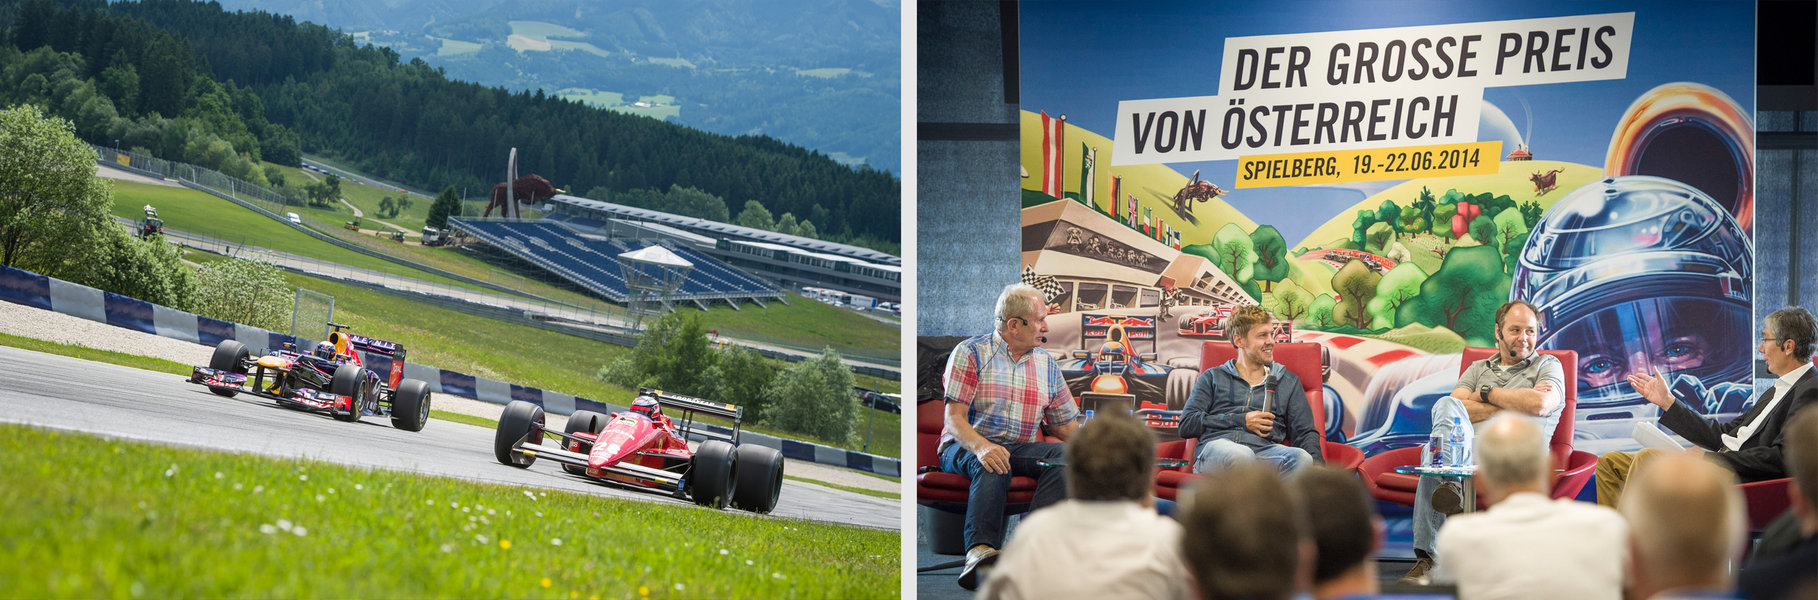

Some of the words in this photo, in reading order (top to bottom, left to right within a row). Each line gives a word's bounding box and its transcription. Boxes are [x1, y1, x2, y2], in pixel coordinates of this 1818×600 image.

[1233, 45, 1311, 91] DER
[1326, 34, 1482, 86] GROSSE
[1494, 25, 1616, 76] PREIS
[1132, 109, 1207, 155] VON
[1221, 94, 1459, 150] ÖSTERREICH
[1243, 156, 1342, 181] SPIELBERG,
[1352, 148, 1480, 174] 19.-22.06.2014
